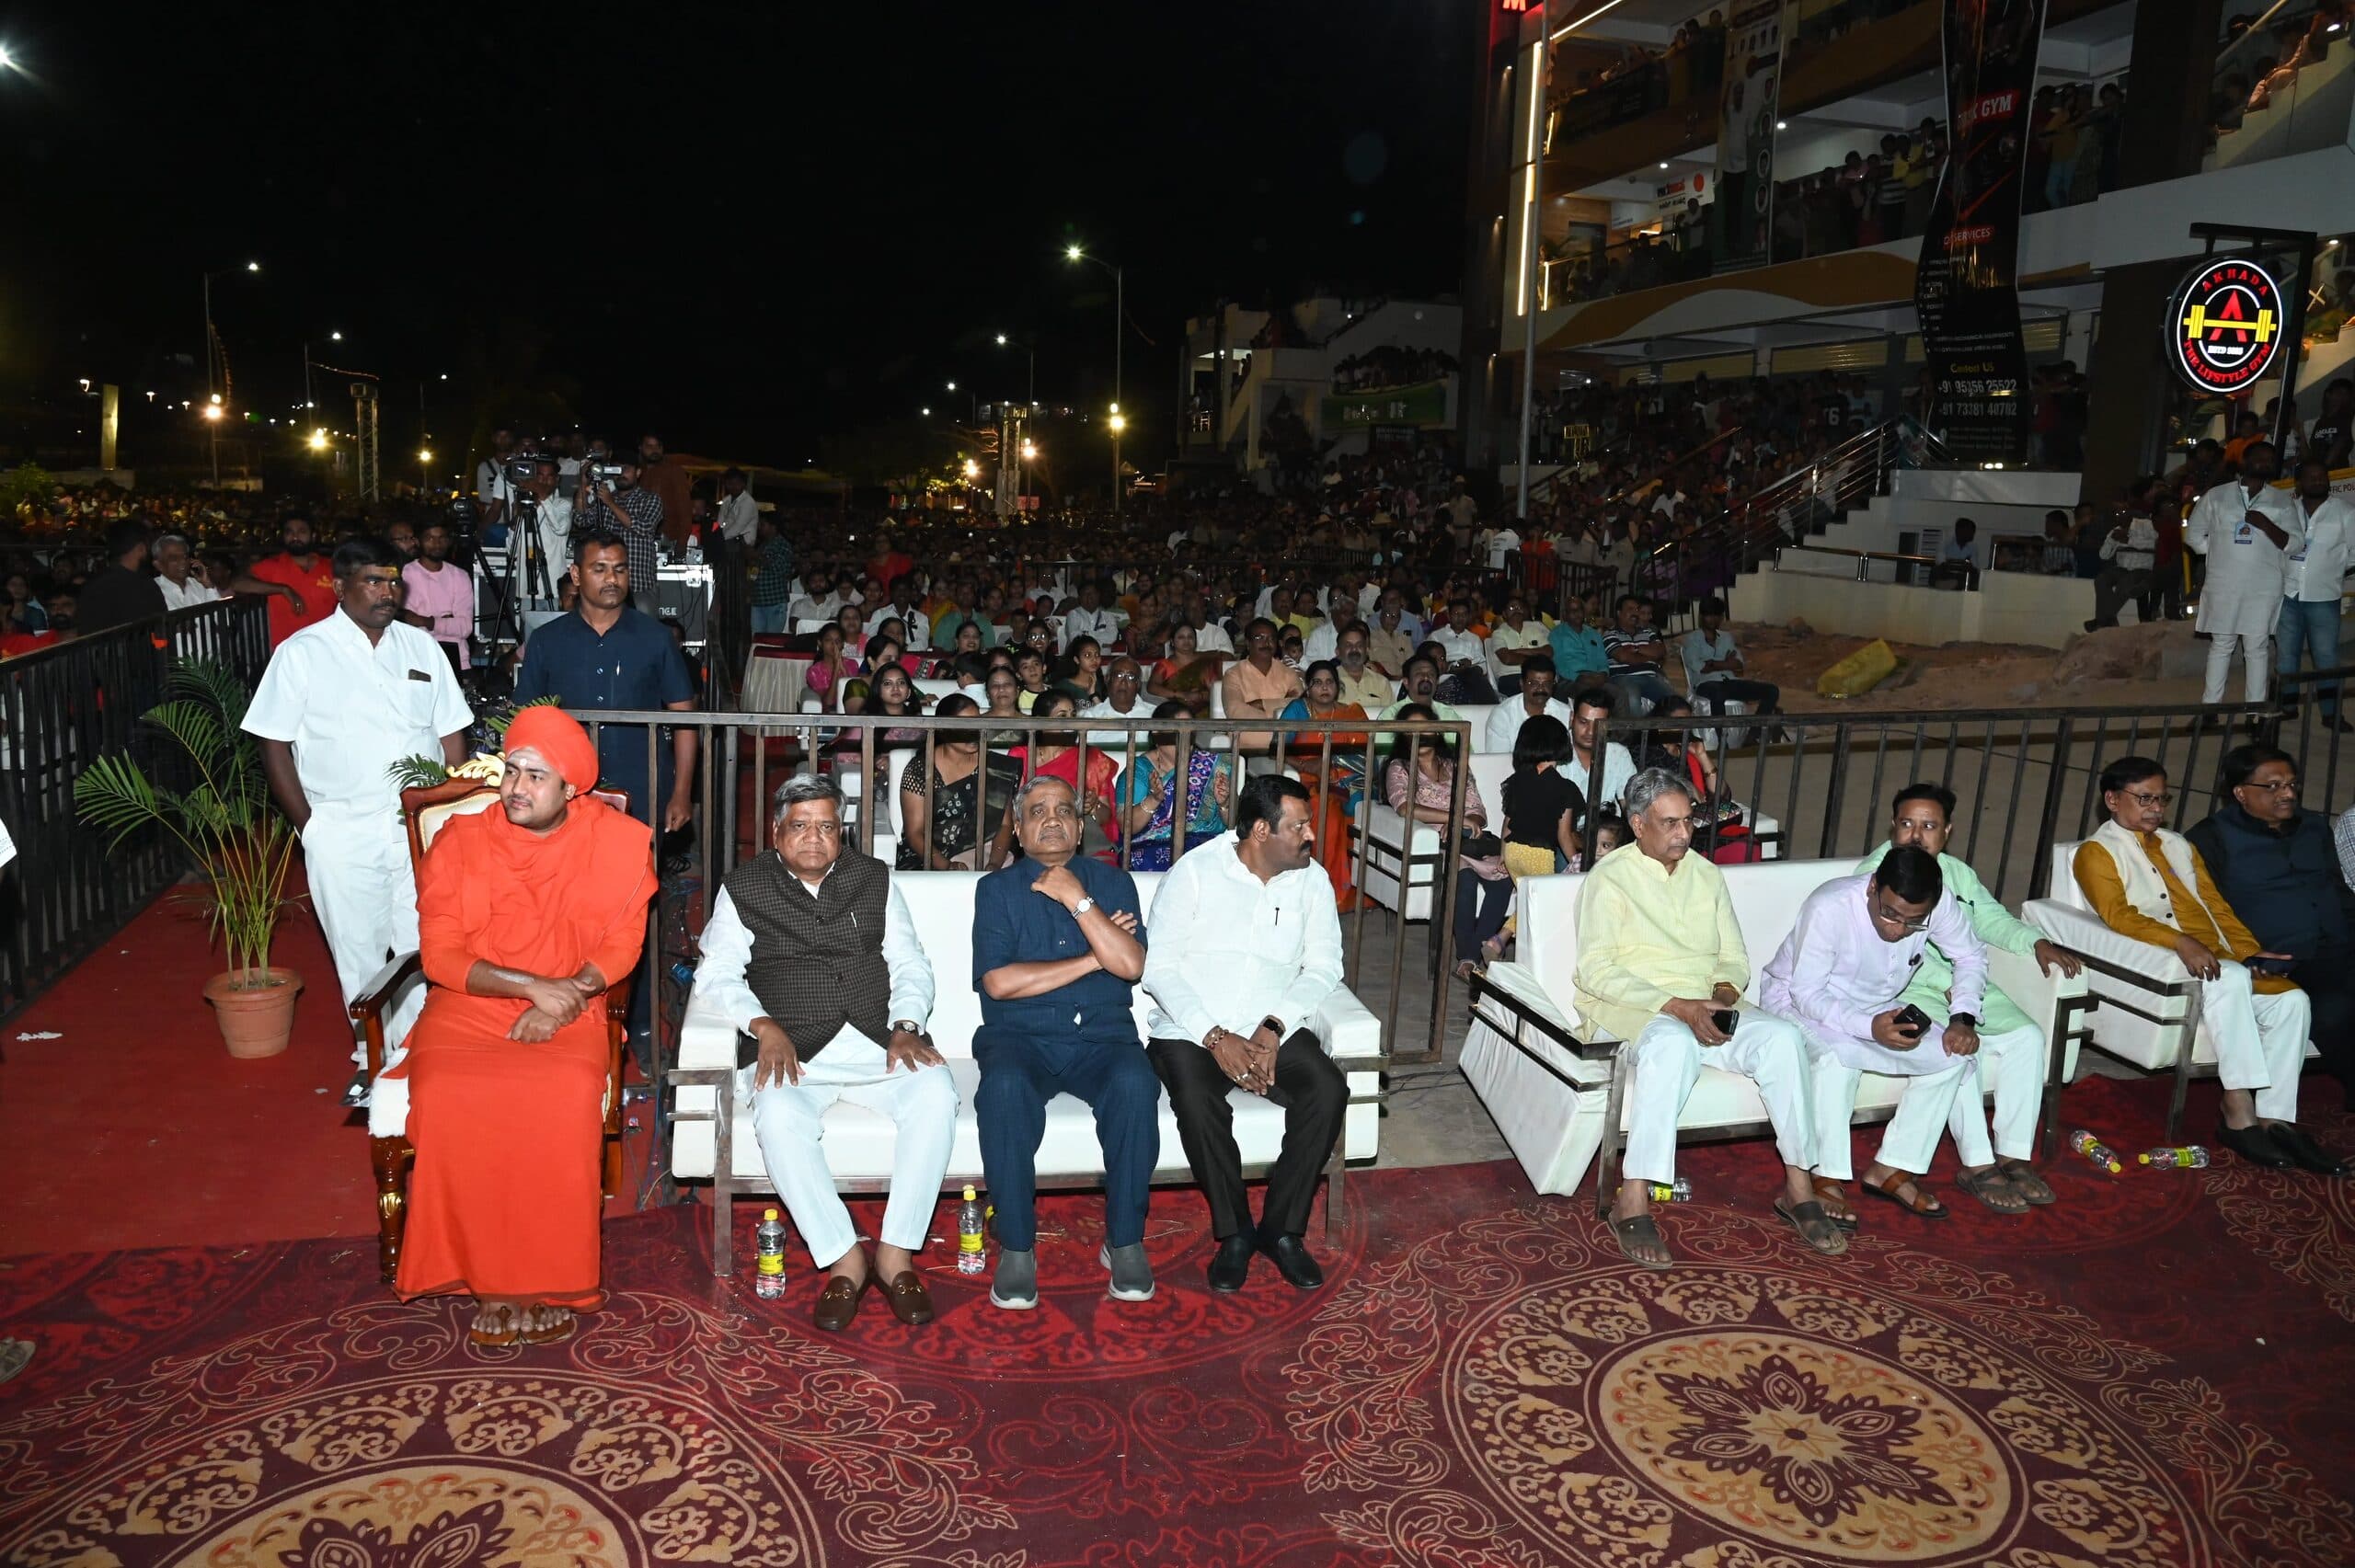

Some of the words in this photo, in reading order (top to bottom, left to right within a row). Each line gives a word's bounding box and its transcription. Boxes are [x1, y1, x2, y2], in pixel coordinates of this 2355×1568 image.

[1982, 94, 2013, 118] GYM
[1953, 227, 1993, 243] SERVICES
[2202, 268, 2269, 296] AKHADA
[2184, 338, 2200, 368] THE
[2249, 343, 2271, 371] GYM
